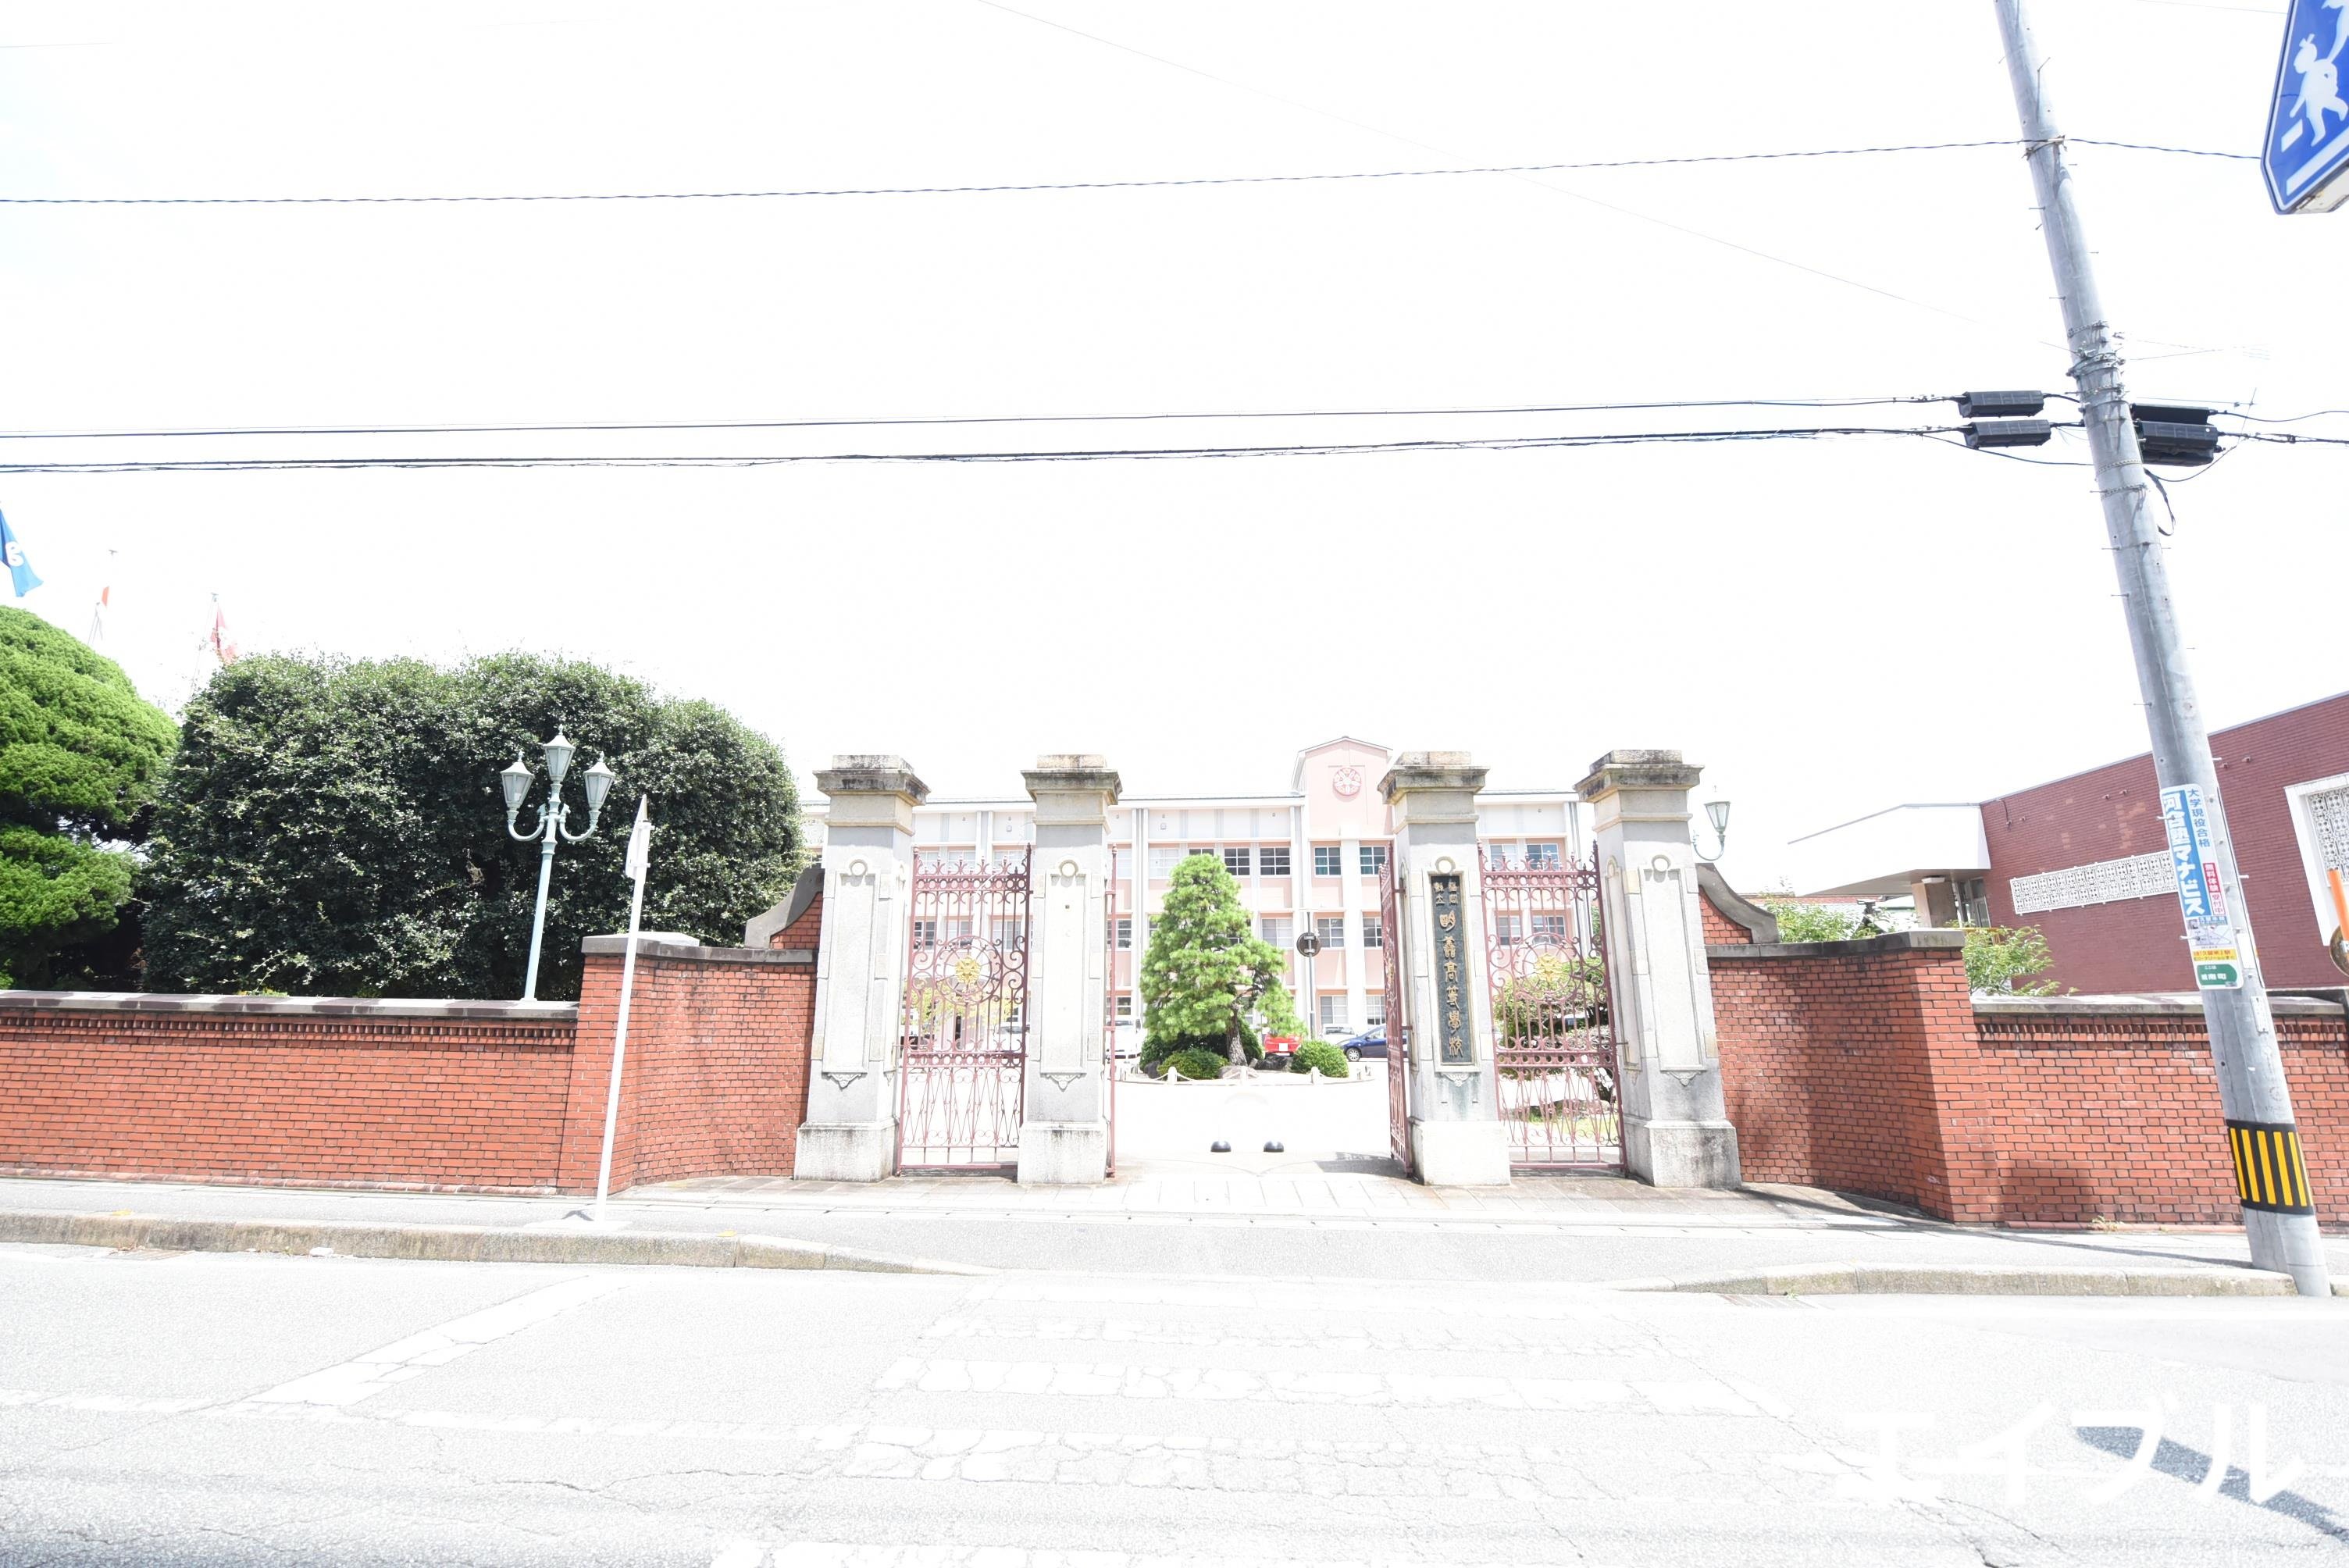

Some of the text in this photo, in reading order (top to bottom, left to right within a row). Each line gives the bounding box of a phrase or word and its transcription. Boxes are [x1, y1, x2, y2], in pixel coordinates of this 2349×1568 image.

[2187, 789, 2211, 847] 大学現役合格
[2162, 793, 2205, 917] 河合塾マナビス
[2212, 894, 2223, 914] 受付中
